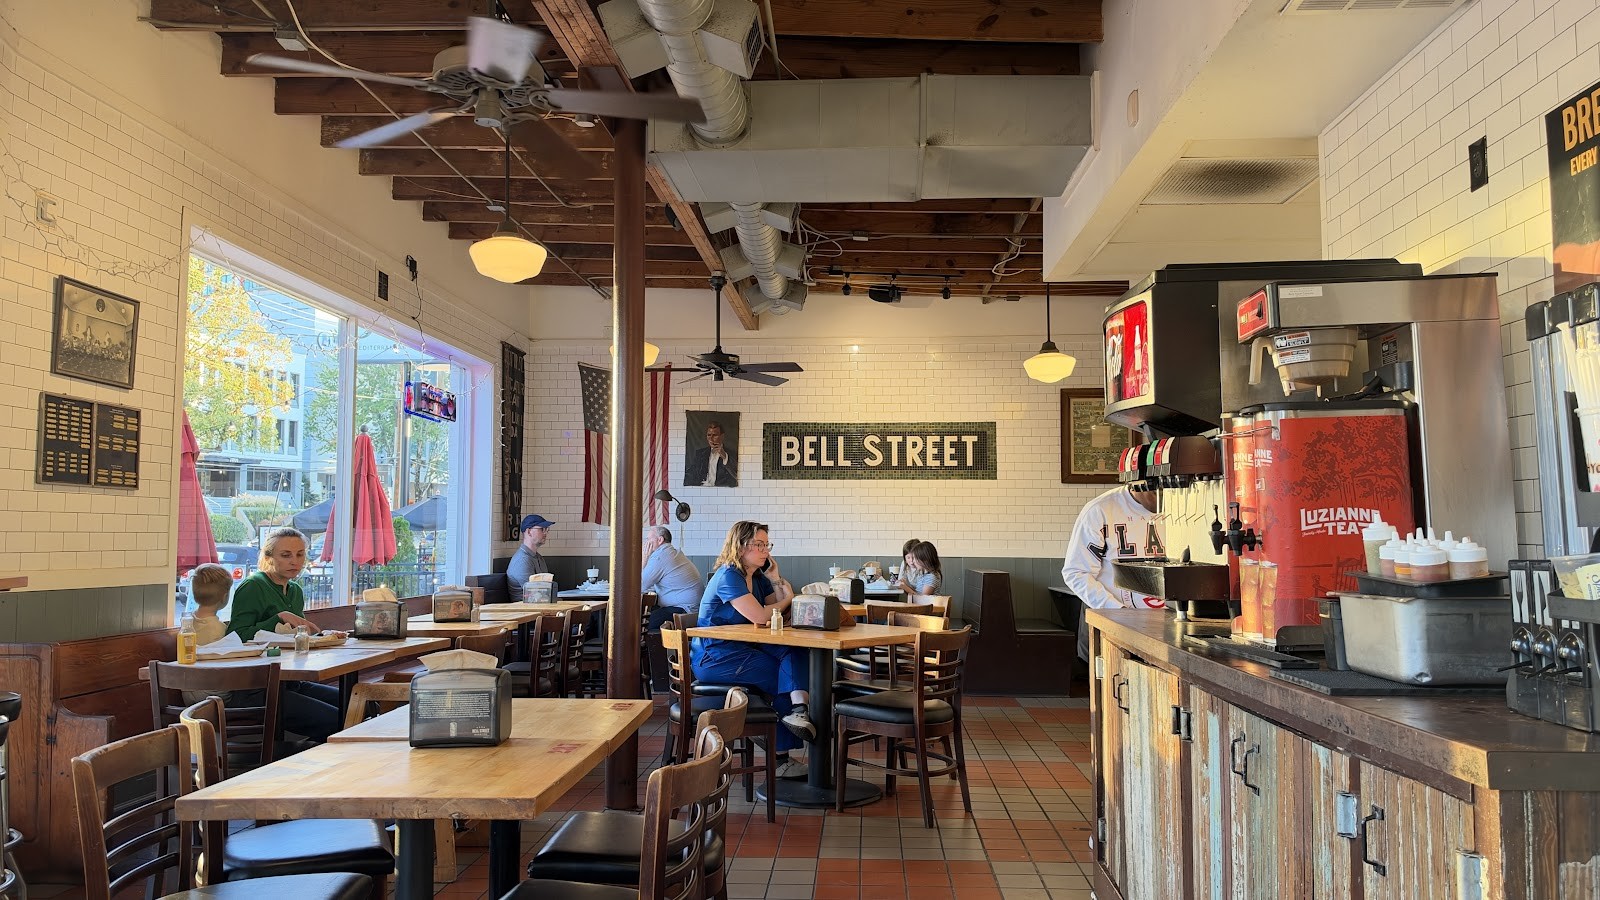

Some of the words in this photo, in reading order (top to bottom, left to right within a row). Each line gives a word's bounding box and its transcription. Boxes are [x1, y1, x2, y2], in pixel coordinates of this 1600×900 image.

[1571, 145, 1597, 177] EVERY
[781, 436, 851, 466] BELL
[863, 434, 978, 466] STREET
[1324, 521, 1359, 535] TEA
